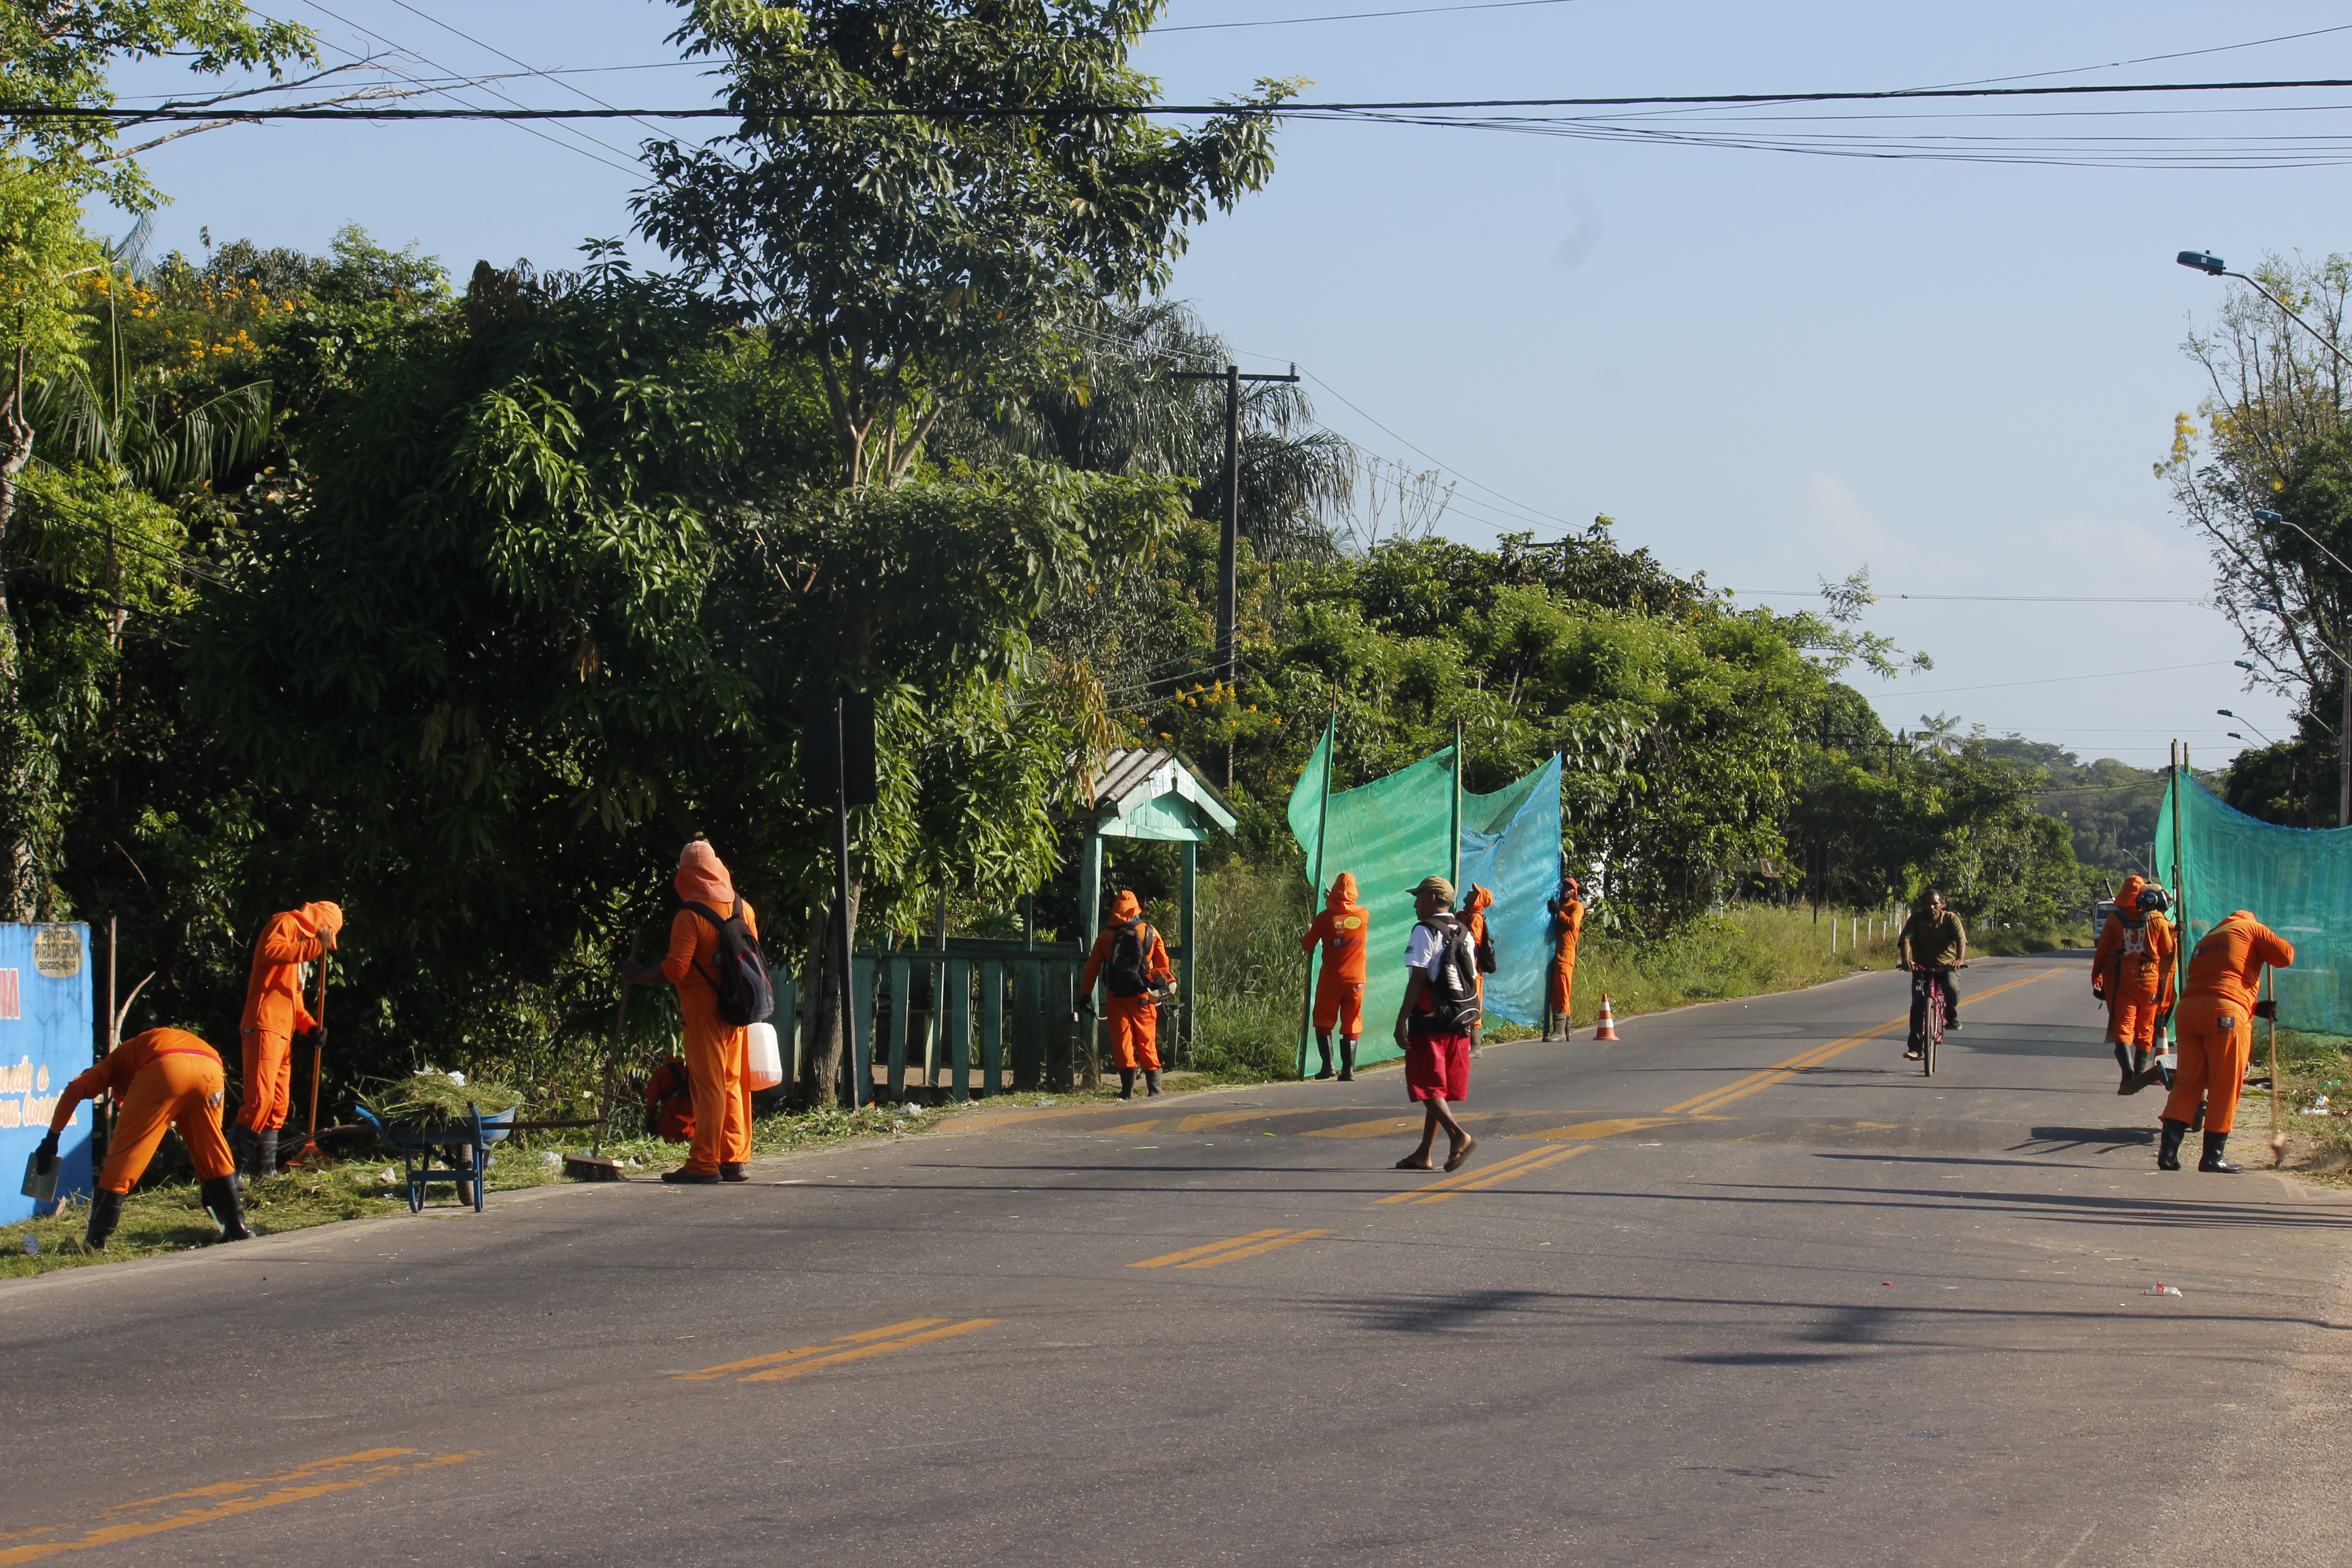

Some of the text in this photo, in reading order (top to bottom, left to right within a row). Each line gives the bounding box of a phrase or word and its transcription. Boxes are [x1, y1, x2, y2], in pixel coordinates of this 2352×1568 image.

[1445, 964, 1464, 992] NIKE
[0, 1055, 49, 1094] ende a
